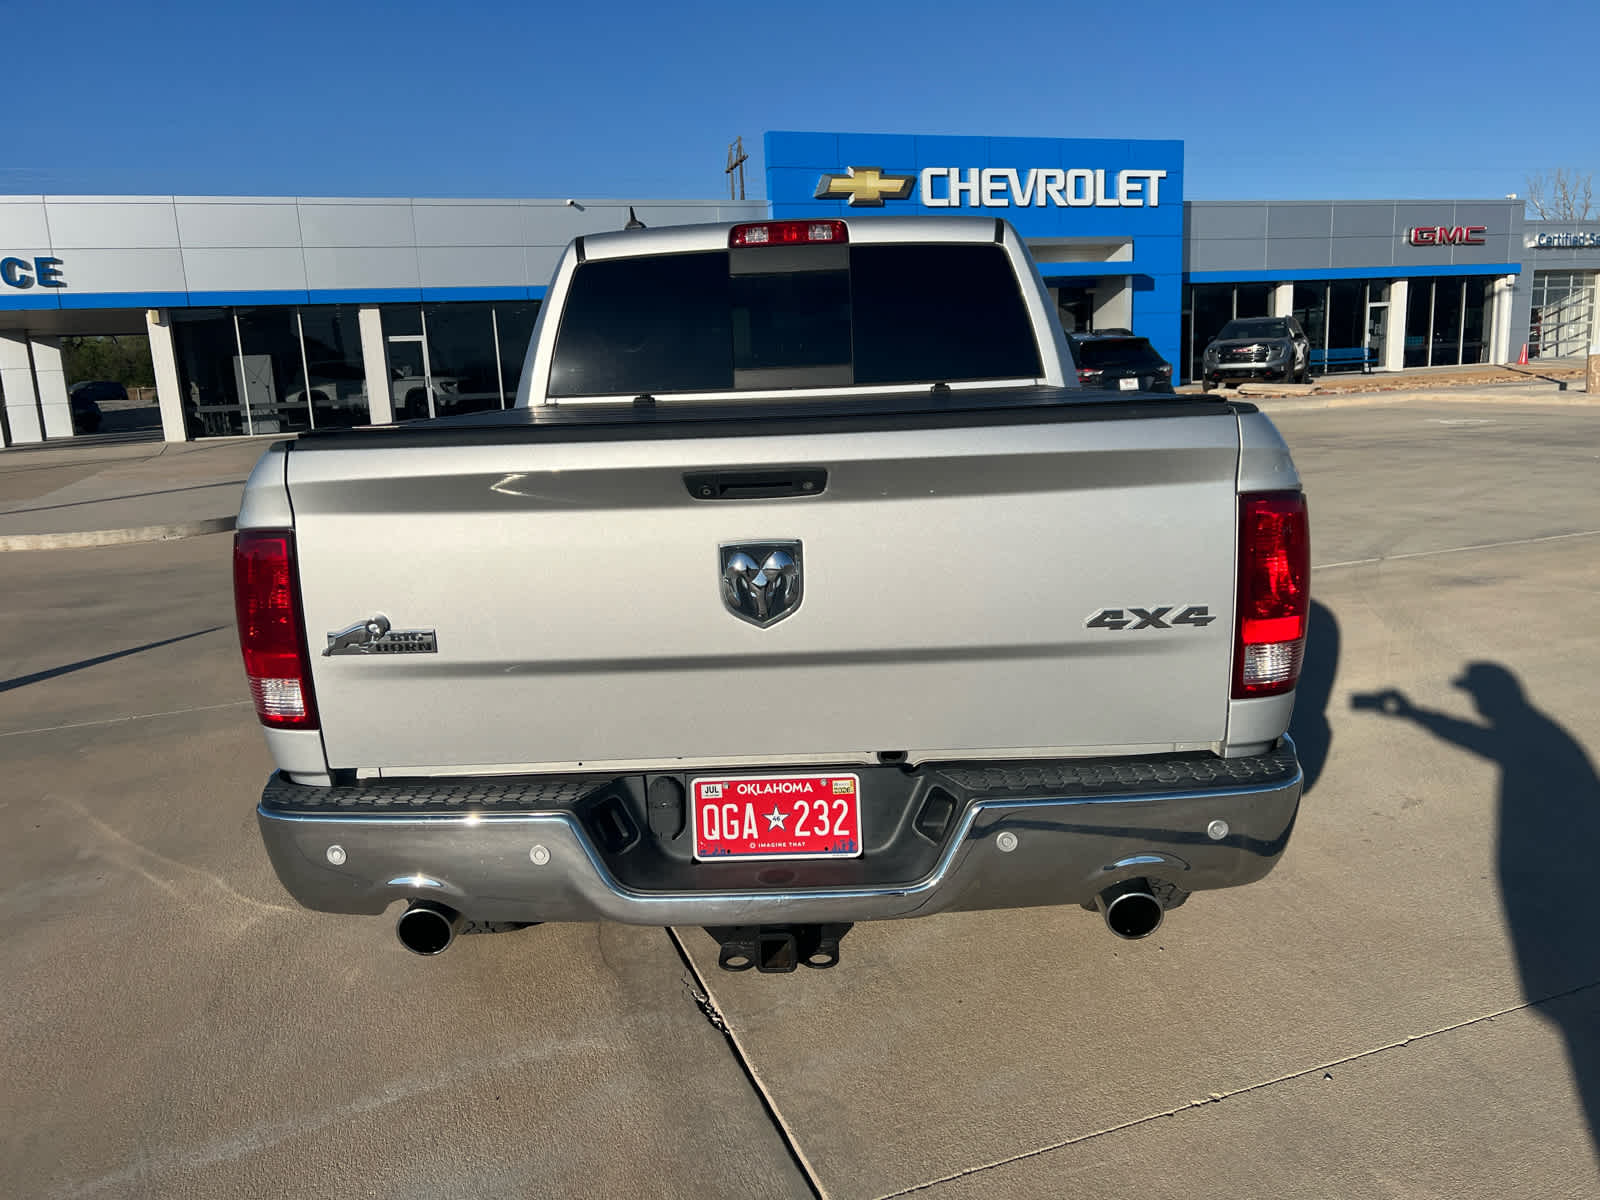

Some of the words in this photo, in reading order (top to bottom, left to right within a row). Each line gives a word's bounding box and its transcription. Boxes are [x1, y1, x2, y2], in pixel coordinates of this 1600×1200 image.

[921, 168, 1167, 207] CHEVROLET
[1411, 226, 1487, 244] GMC
[1538, 232, 1585, 248] Certified
[0, 256, 66, 288] CE
[389, 632, 424, 641] BIG
[375, 641, 432, 652] HORN
[704, 785, 720, 794] JUL
[736, 782, 814, 796] OKLAHOMA
[702, 803, 759, 840] QGA
[793, 799, 850, 837] 232
[758, 841, 787, 849] IMAGINE
[789, 840, 806, 848] THAT
